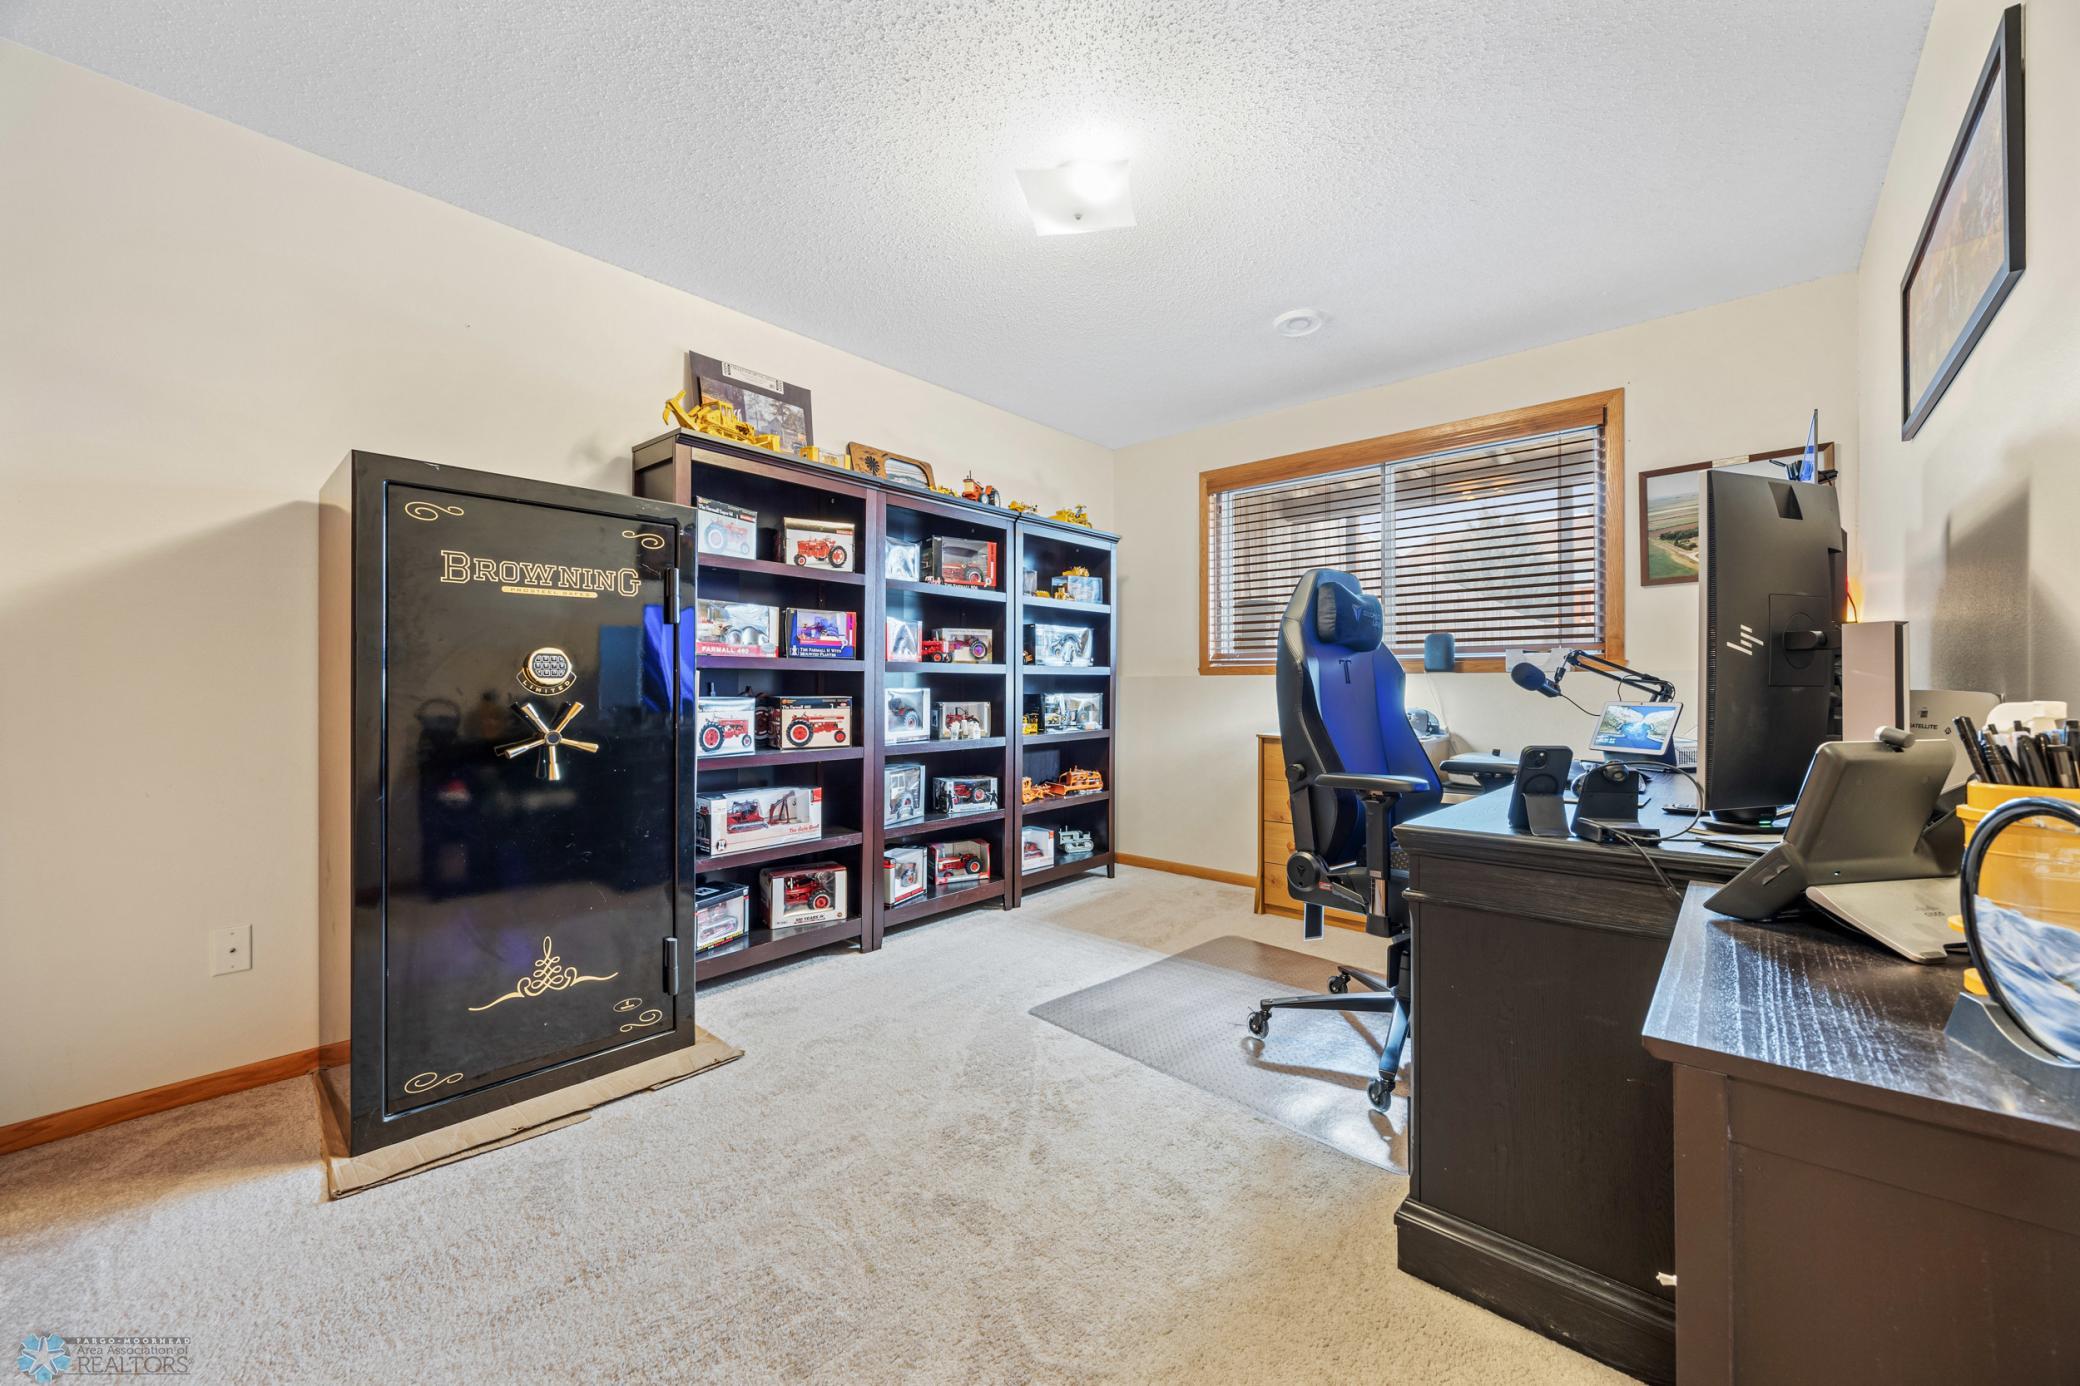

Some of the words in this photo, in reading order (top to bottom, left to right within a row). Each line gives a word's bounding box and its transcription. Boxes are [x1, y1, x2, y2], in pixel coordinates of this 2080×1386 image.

[440, 550, 642, 597] BROWNING
[702, 646, 735, 654] FARMALL
[522, 680, 570, 693] LIMITED
